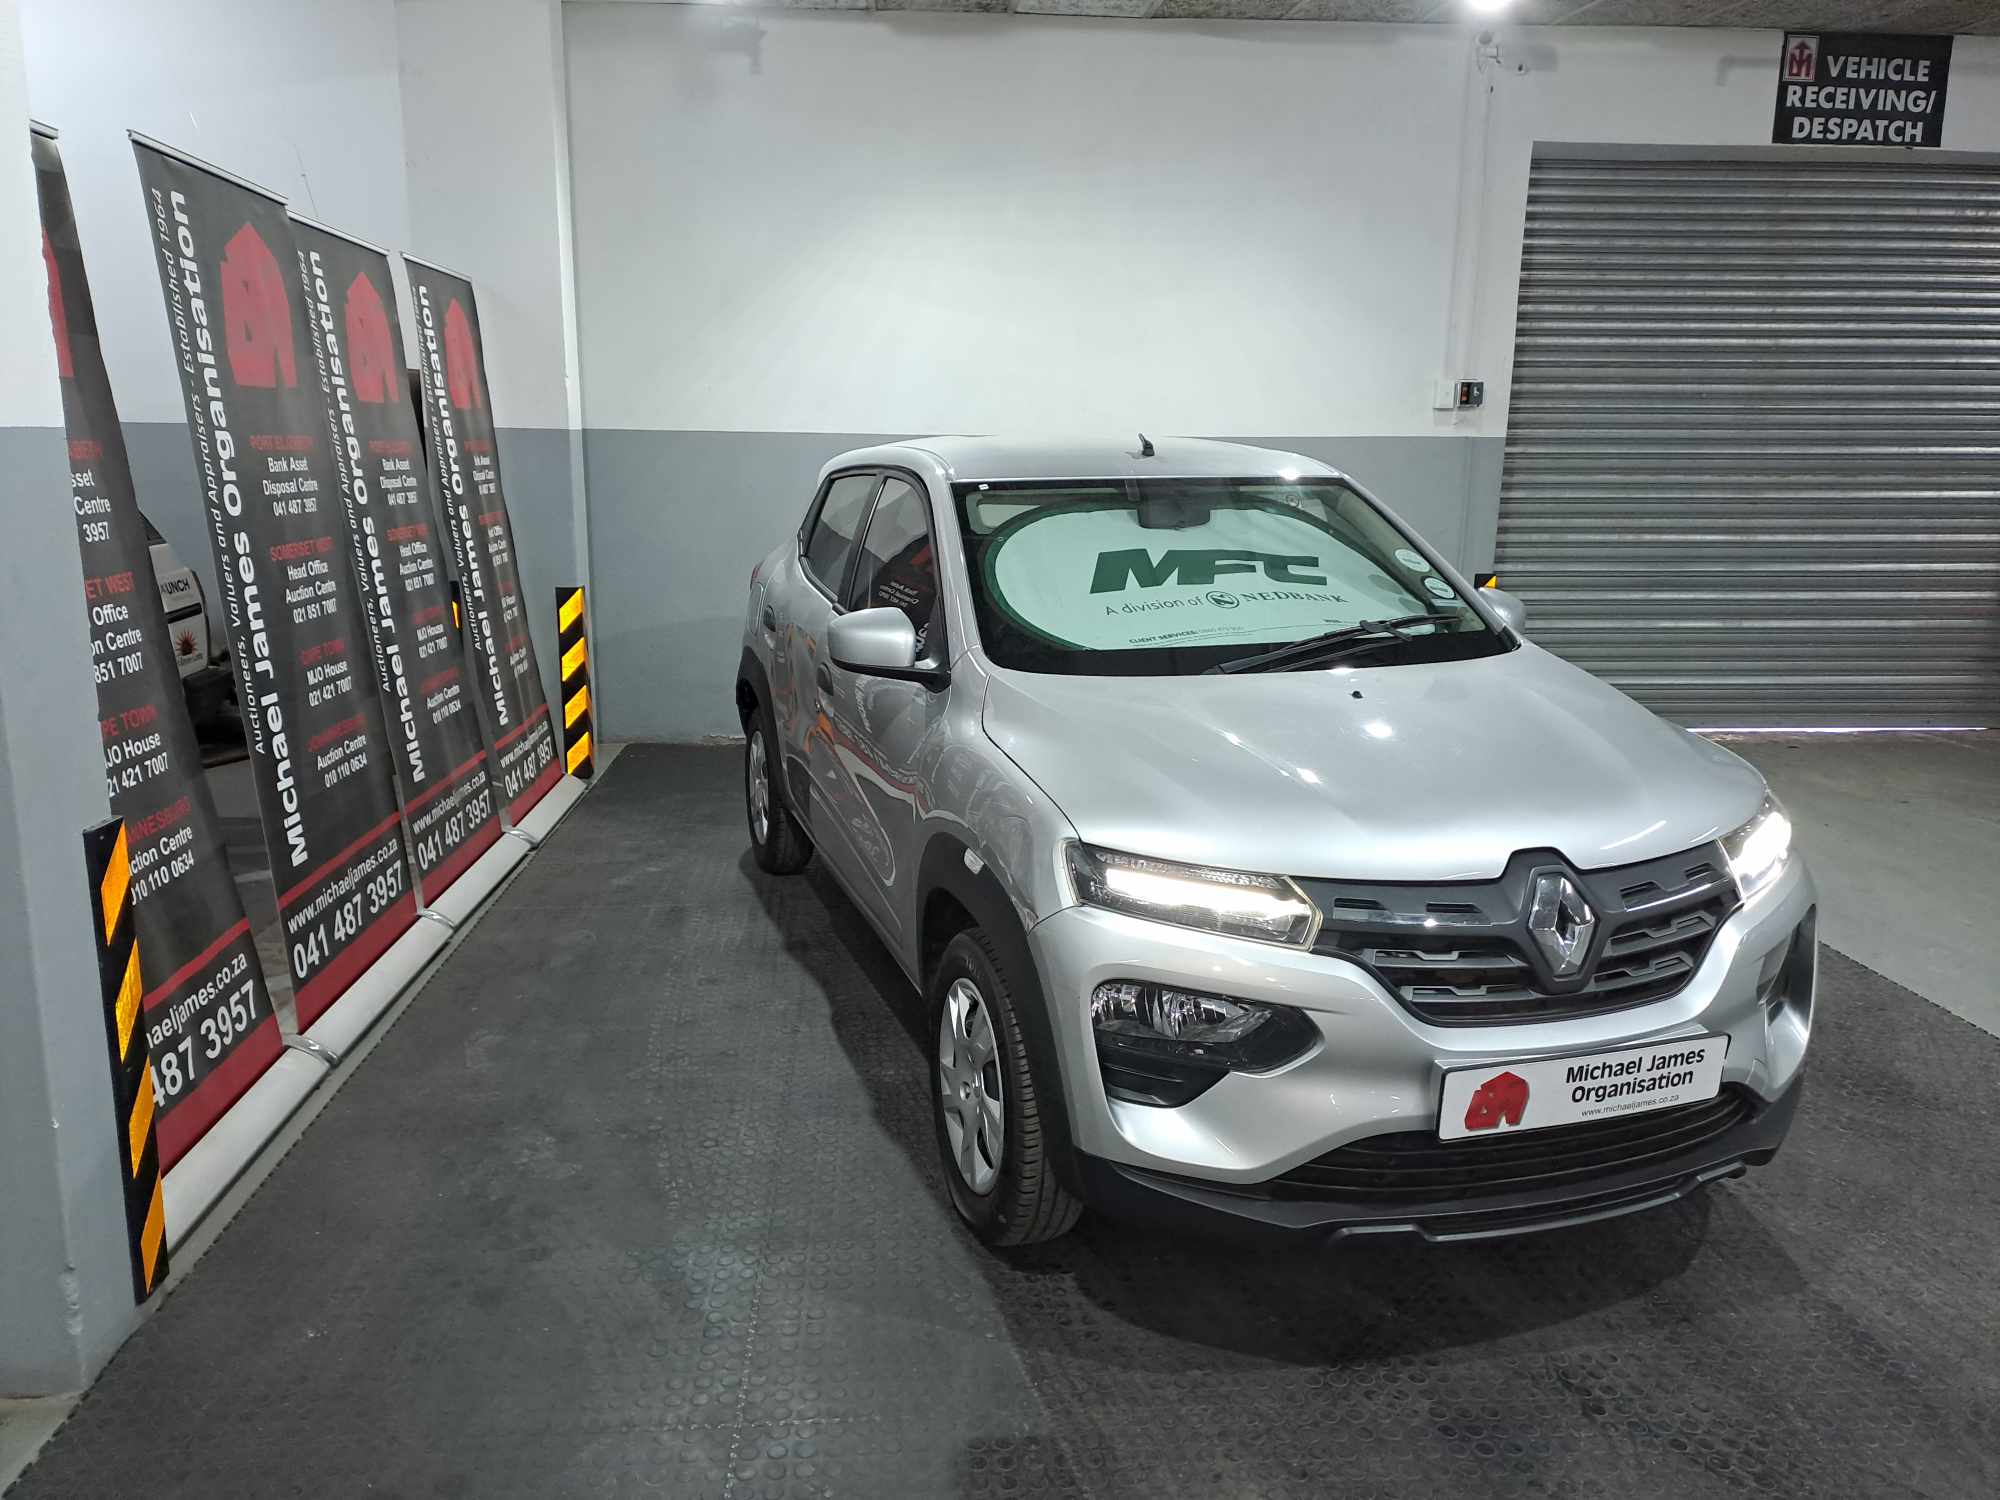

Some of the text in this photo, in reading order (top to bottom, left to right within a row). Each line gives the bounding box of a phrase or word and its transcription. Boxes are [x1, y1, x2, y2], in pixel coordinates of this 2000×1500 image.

[1827, 55, 1931, 82] VEHICLE
[1786, 85, 1936, 114] RECEIVING/
[1791, 116, 1923, 143] DESPATCH
[151, 187, 171, 243] 1964
[161, 247, 195, 374] Established
[418, 285, 464, 496] Organisation
[191, 393, 219, 504] Appraisers
[268, 457, 288, 473] Bank
[327, 407, 354, 497] Appraisers
[74, 496, 111, 516] Centre
[263, 478, 297, 498] Disposal
[273, 501, 287, 517] 041
[288, 499, 302, 515] 487
[309, 250, 426, 784] Michael James Organisation
[344, 498, 359, 529] and
[83, 521, 110, 543] 3957
[170, 190, 308, 867] Michael James Organisation
[210, 508, 227, 548] and
[287, 559, 328, 581] Head Office
[352, 533, 370, 592] Valuers
[458, 504, 485, 603] James
[1089, 548, 1328, 594] MFC
[221, 554, 242, 628] Valuers
[286, 579, 336, 604] Auction Centre
[1106, 591, 1350, 616] A division of NEDBANK
[92, 603, 129, 627] Office
[293, 607, 306, 624] 021
[306, 603, 321, 620] 851
[106, 627, 142, 651] Centre
[93, 652, 144, 682] 851 7007
[307, 660, 348, 686] MJO House
[478, 610, 509, 726] Michael
[237, 635, 265, 755] Auctioneers,
[308, 676, 352, 707] 021 421 7007
[104, 732, 161, 769] JO House
[317, 734, 367, 771] Auction Centre
[122, 764, 143, 789] 421
[145, 751, 169, 779] 7007
[324, 752, 368, 788] 010 110 0634
[504, 766, 524, 799] 041
[523, 751, 537, 781] 487
[160, 825, 193, 856] Centre
[417, 788, 491, 871] 041 487 3957
[149, 865, 170, 892] 110
[171, 849, 195, 879] 0634
[287, 838, 399, 935] www.michaeljames.co.za
[293, 859, 403, 979] 041 487 3957
[200, 978, 257, 1060] 3957
[1566, 1048, 1705, 1084] Michael James
[1571, 1070, 1694, 1103] Organisation
[1581, 1094, 1680, 1117] www.michaeljames.co.za
